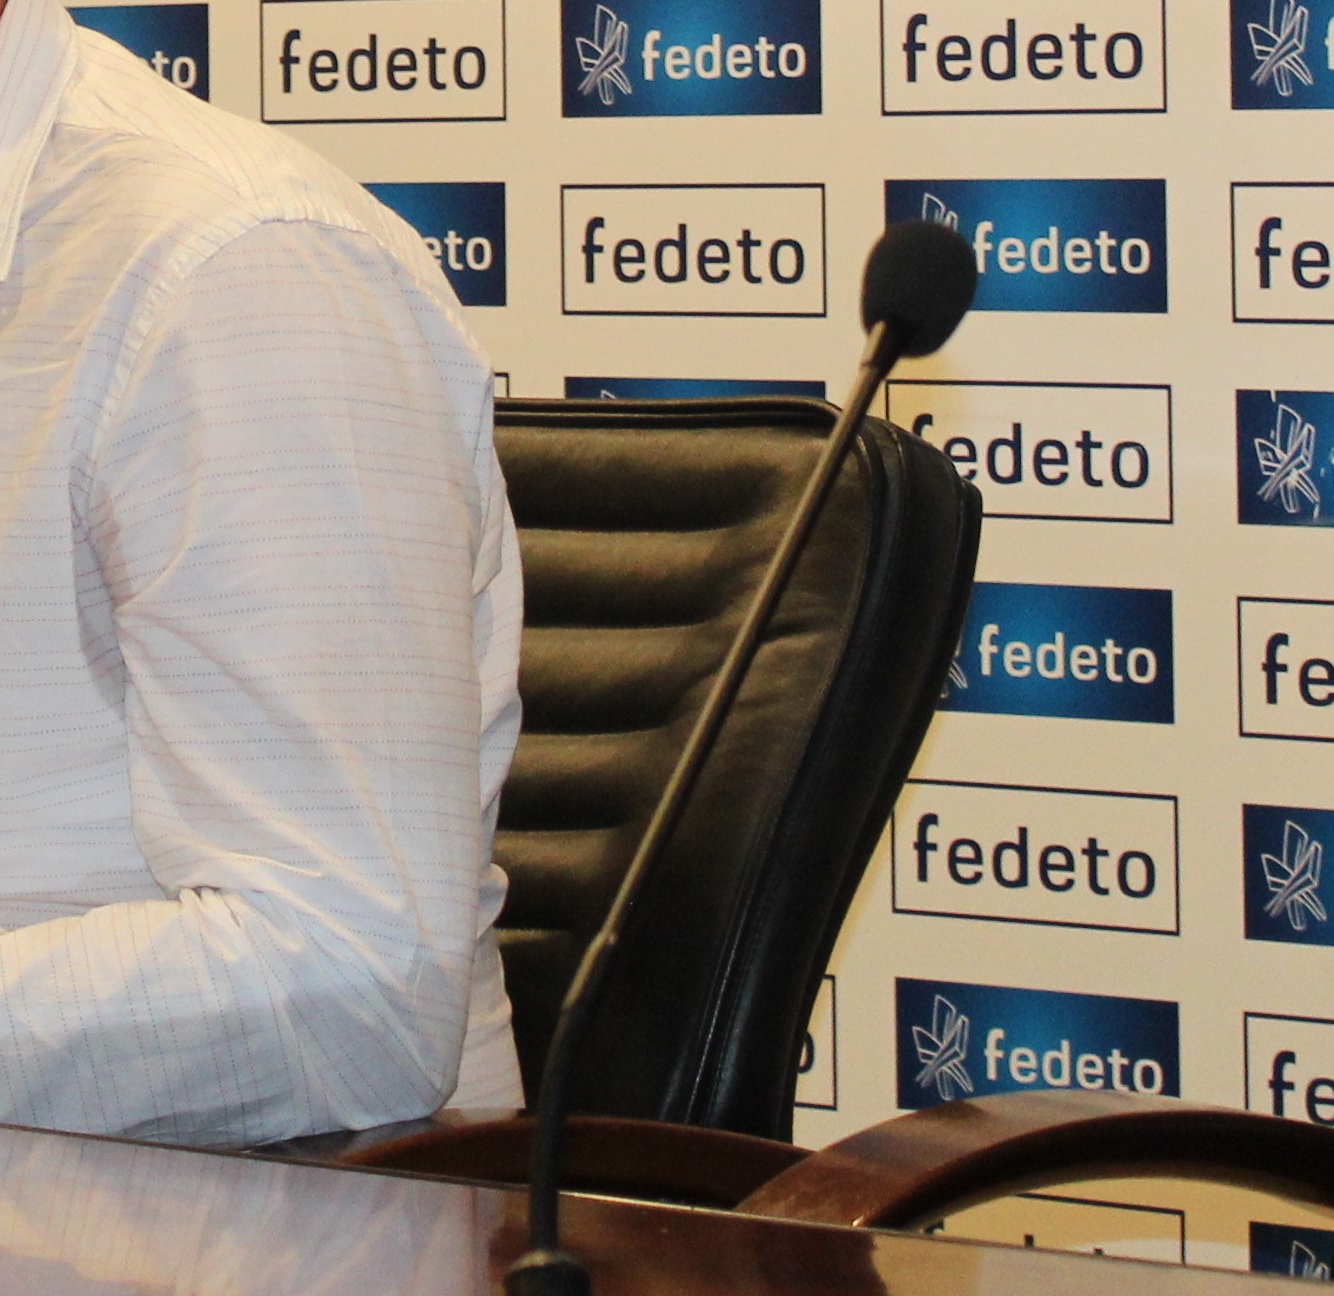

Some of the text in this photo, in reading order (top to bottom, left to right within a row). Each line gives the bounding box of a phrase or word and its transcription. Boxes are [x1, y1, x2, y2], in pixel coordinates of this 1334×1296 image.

[279, 29, 486, 94] fedeto
[641, 29, 806, 81] fedeto
[902, 13, 1143, 83] fedeto
[581, 216, 805, 285] fedeto
[975, 220, 1151, 275] fedeto
[913, 413, 1150, 488] edeto
[978, 623, 1157, 684] fedeto
[913, 812, 1156, 899] fedeto
[983, 1027, 1164, 1095] fedeto
